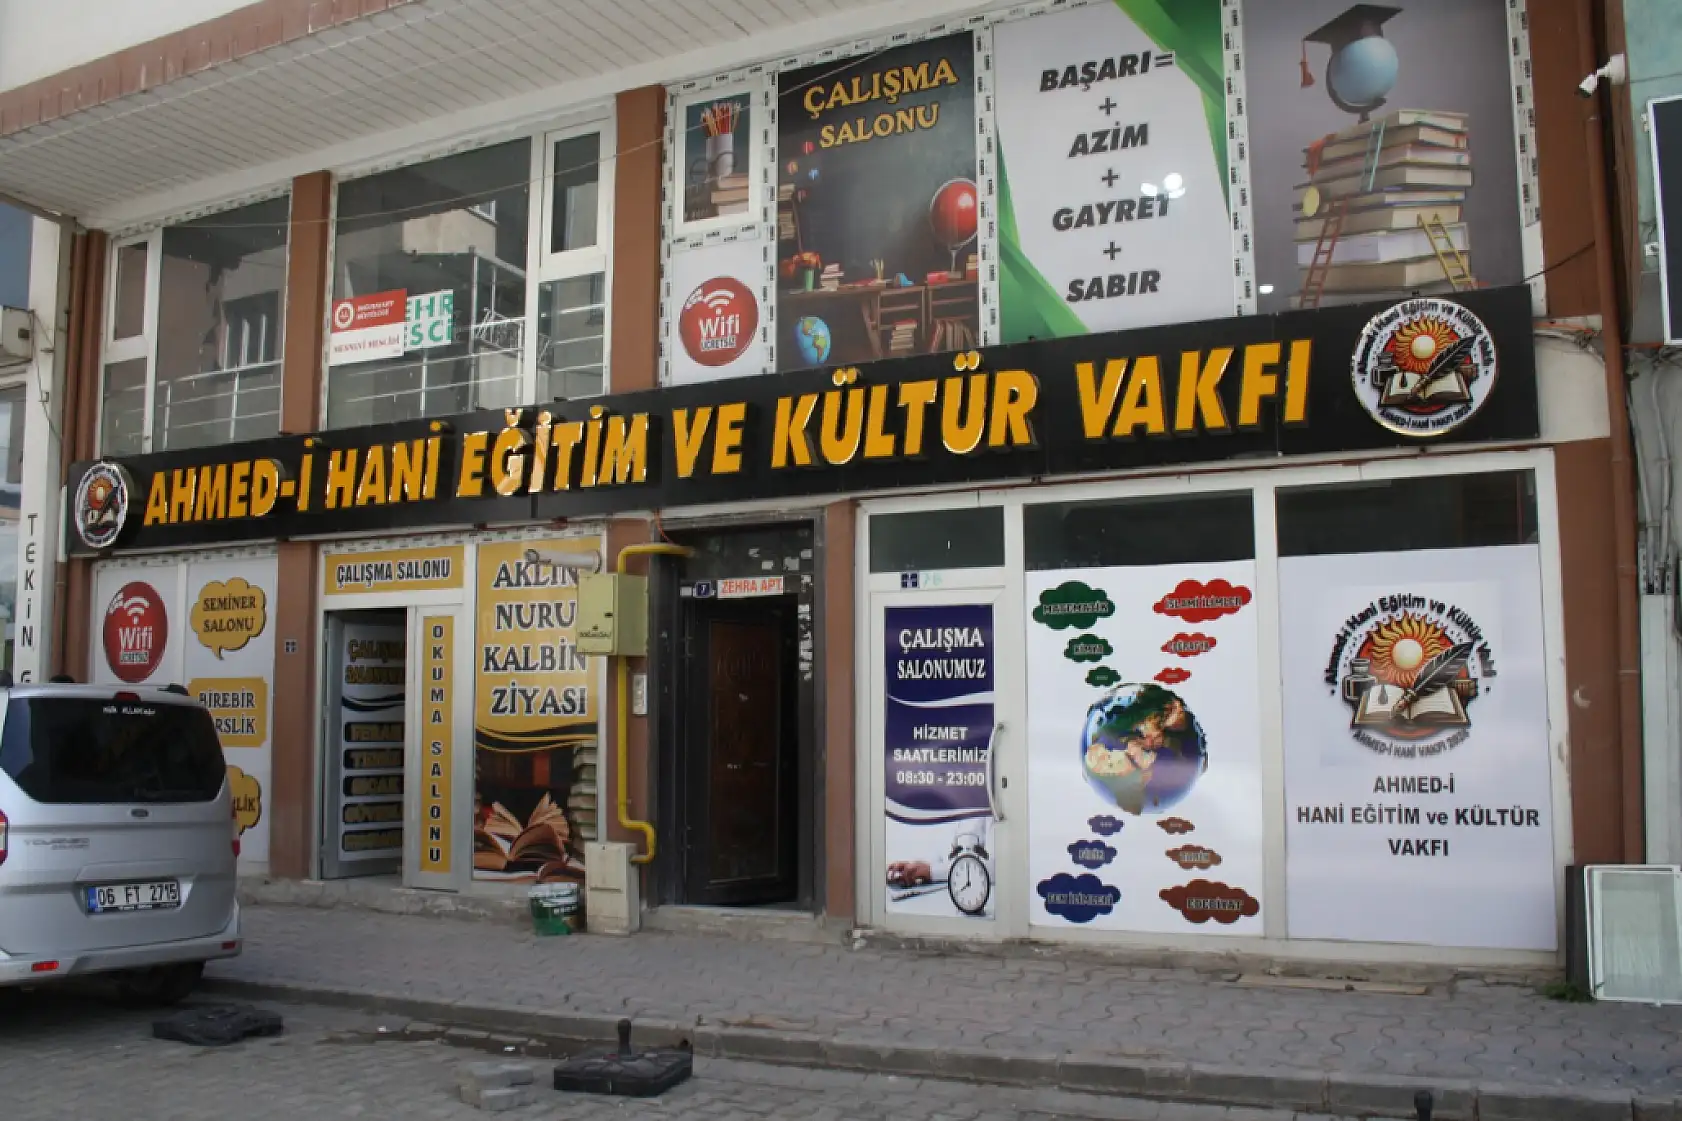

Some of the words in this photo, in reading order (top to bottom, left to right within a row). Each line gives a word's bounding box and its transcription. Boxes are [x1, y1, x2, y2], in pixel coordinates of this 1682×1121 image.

[803, 57, 959, 120] ÇALIŞMA
[819, 102, 940, 148] SALONU
[1068, 121, 1148, 158] AZİM
[1052, 193, 1169, 231] GAYRET
[1066, 270, 1161, 302] SABIR
[699, 313, 740, 338] Wifi
[143, 437, 313, 526] AHMED-İ
[325, 420, 441, 509] HANİ
[455, 405, 649, 498] EĞİTİM
[672, 401, 747, 478] VE
[771, 350, 1038, 469] KÜLTÜR
[1075, 339, 1312, 439] VAKFI
[336, 561, 393, 589] ÇALIŞMA
[397, 557, 452, 581] SALONU
[493, 560, 579, 589] AKLIN
[722, 579, 758, 594] ZEHRA
[203, 593, 256, 612] SEMİNER
[1379, 593, 1426, 612] Eğitim
[1430, 599, 1446, 614] ve
[203, 617, 255, 633] SALONU
[496, 602, 577, 630] NURU
[119, 626, 153, 649] Wifi
[899, 627, 985, 654] ÇALIŞMA
[483, 638, 588, 673] KALBİN
[430, 625, 445, 724] OKUMA
[897, 658, 986, 680] SALONUMUZ
[491, 681, 588, 715] ZİYASI
[214, 714, 256, 735] RSLİK
[913, 723, 968, 740] HİZMET
[893, 747, 989, 763] SAATLERİMİZ
[896, 770, 934, 786] 08:30
[946, 771, 986, 787] 23:00
[1373, 772, 1455, 795] AHMED-İ
[429, 741, 444, 863] SALONU
[1297, 803, 1344, 825] HANİ
[1351, 803, 1420, 826] EĞİTİM
[1426, 810, 1449, 826] ve
[1455, 803, 1540, 827] KÜLTÜR
[1388, 838, 1449, 857] VAKFI
[98, 887, 115, 906] 06
[124, 885, 140, 903] FT
